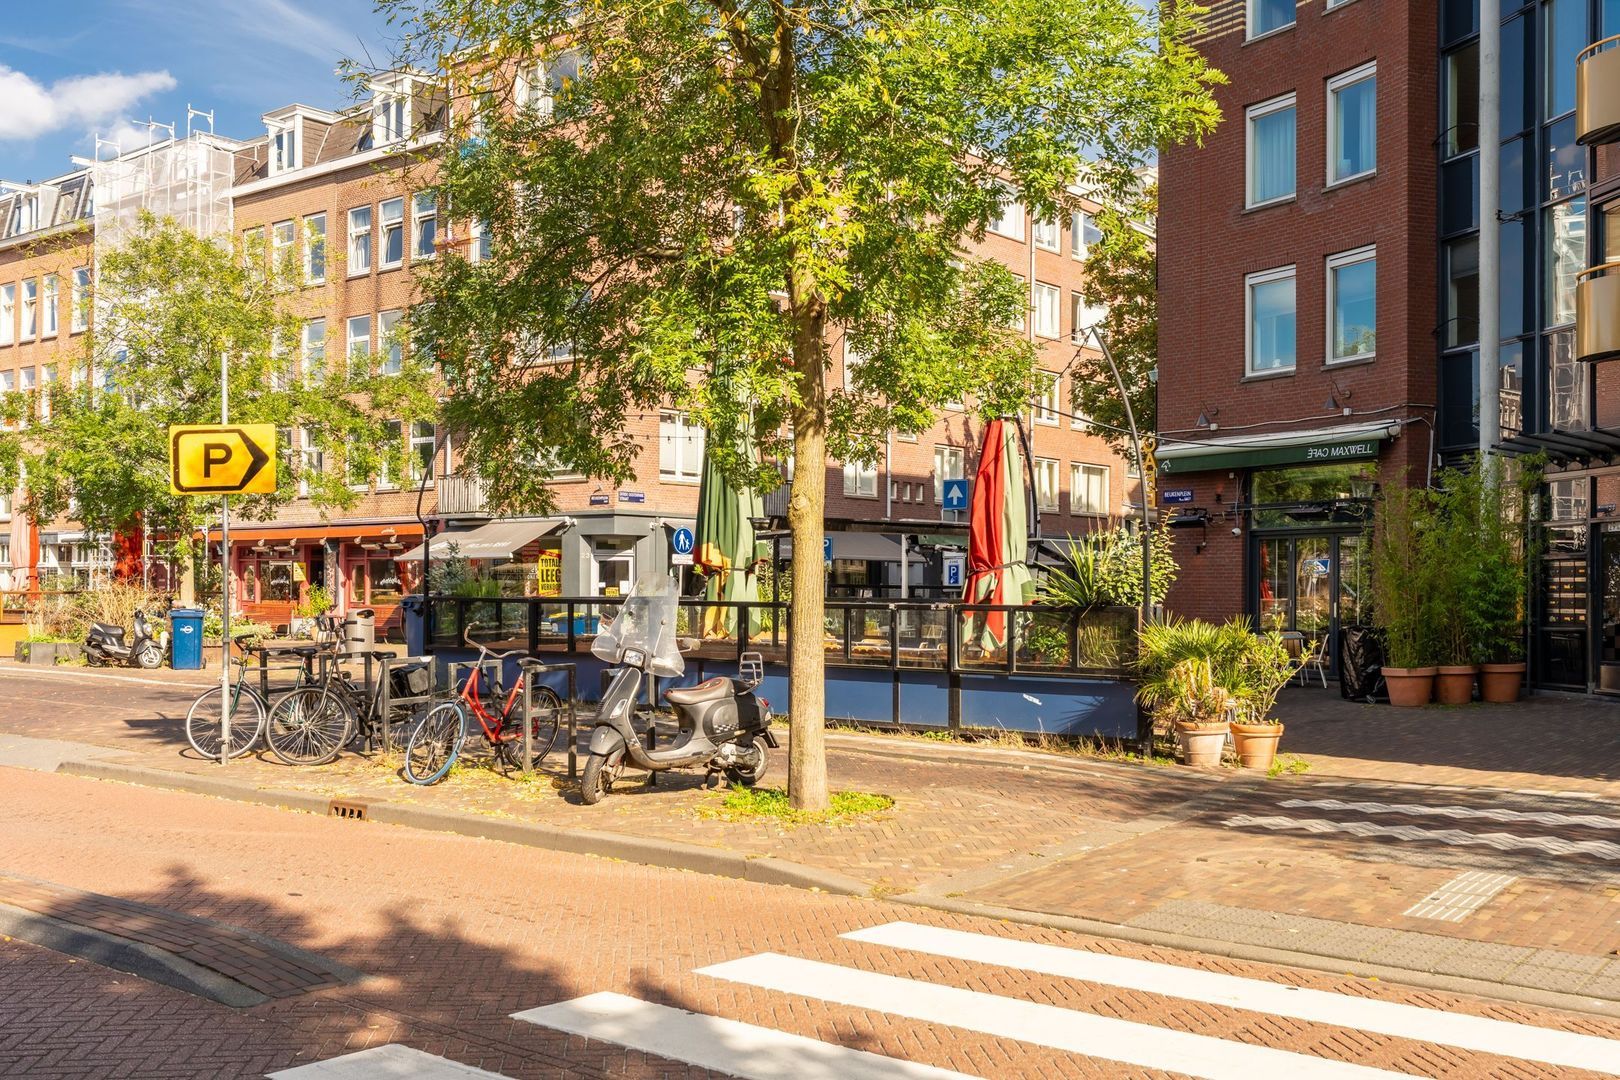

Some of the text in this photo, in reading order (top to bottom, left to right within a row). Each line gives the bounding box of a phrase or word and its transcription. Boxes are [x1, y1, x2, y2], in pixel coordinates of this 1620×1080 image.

[1331, 444, 1373, 457] MAXWELL
[203, 443, 233, 478] P
[950, 566, 957, 576] P
